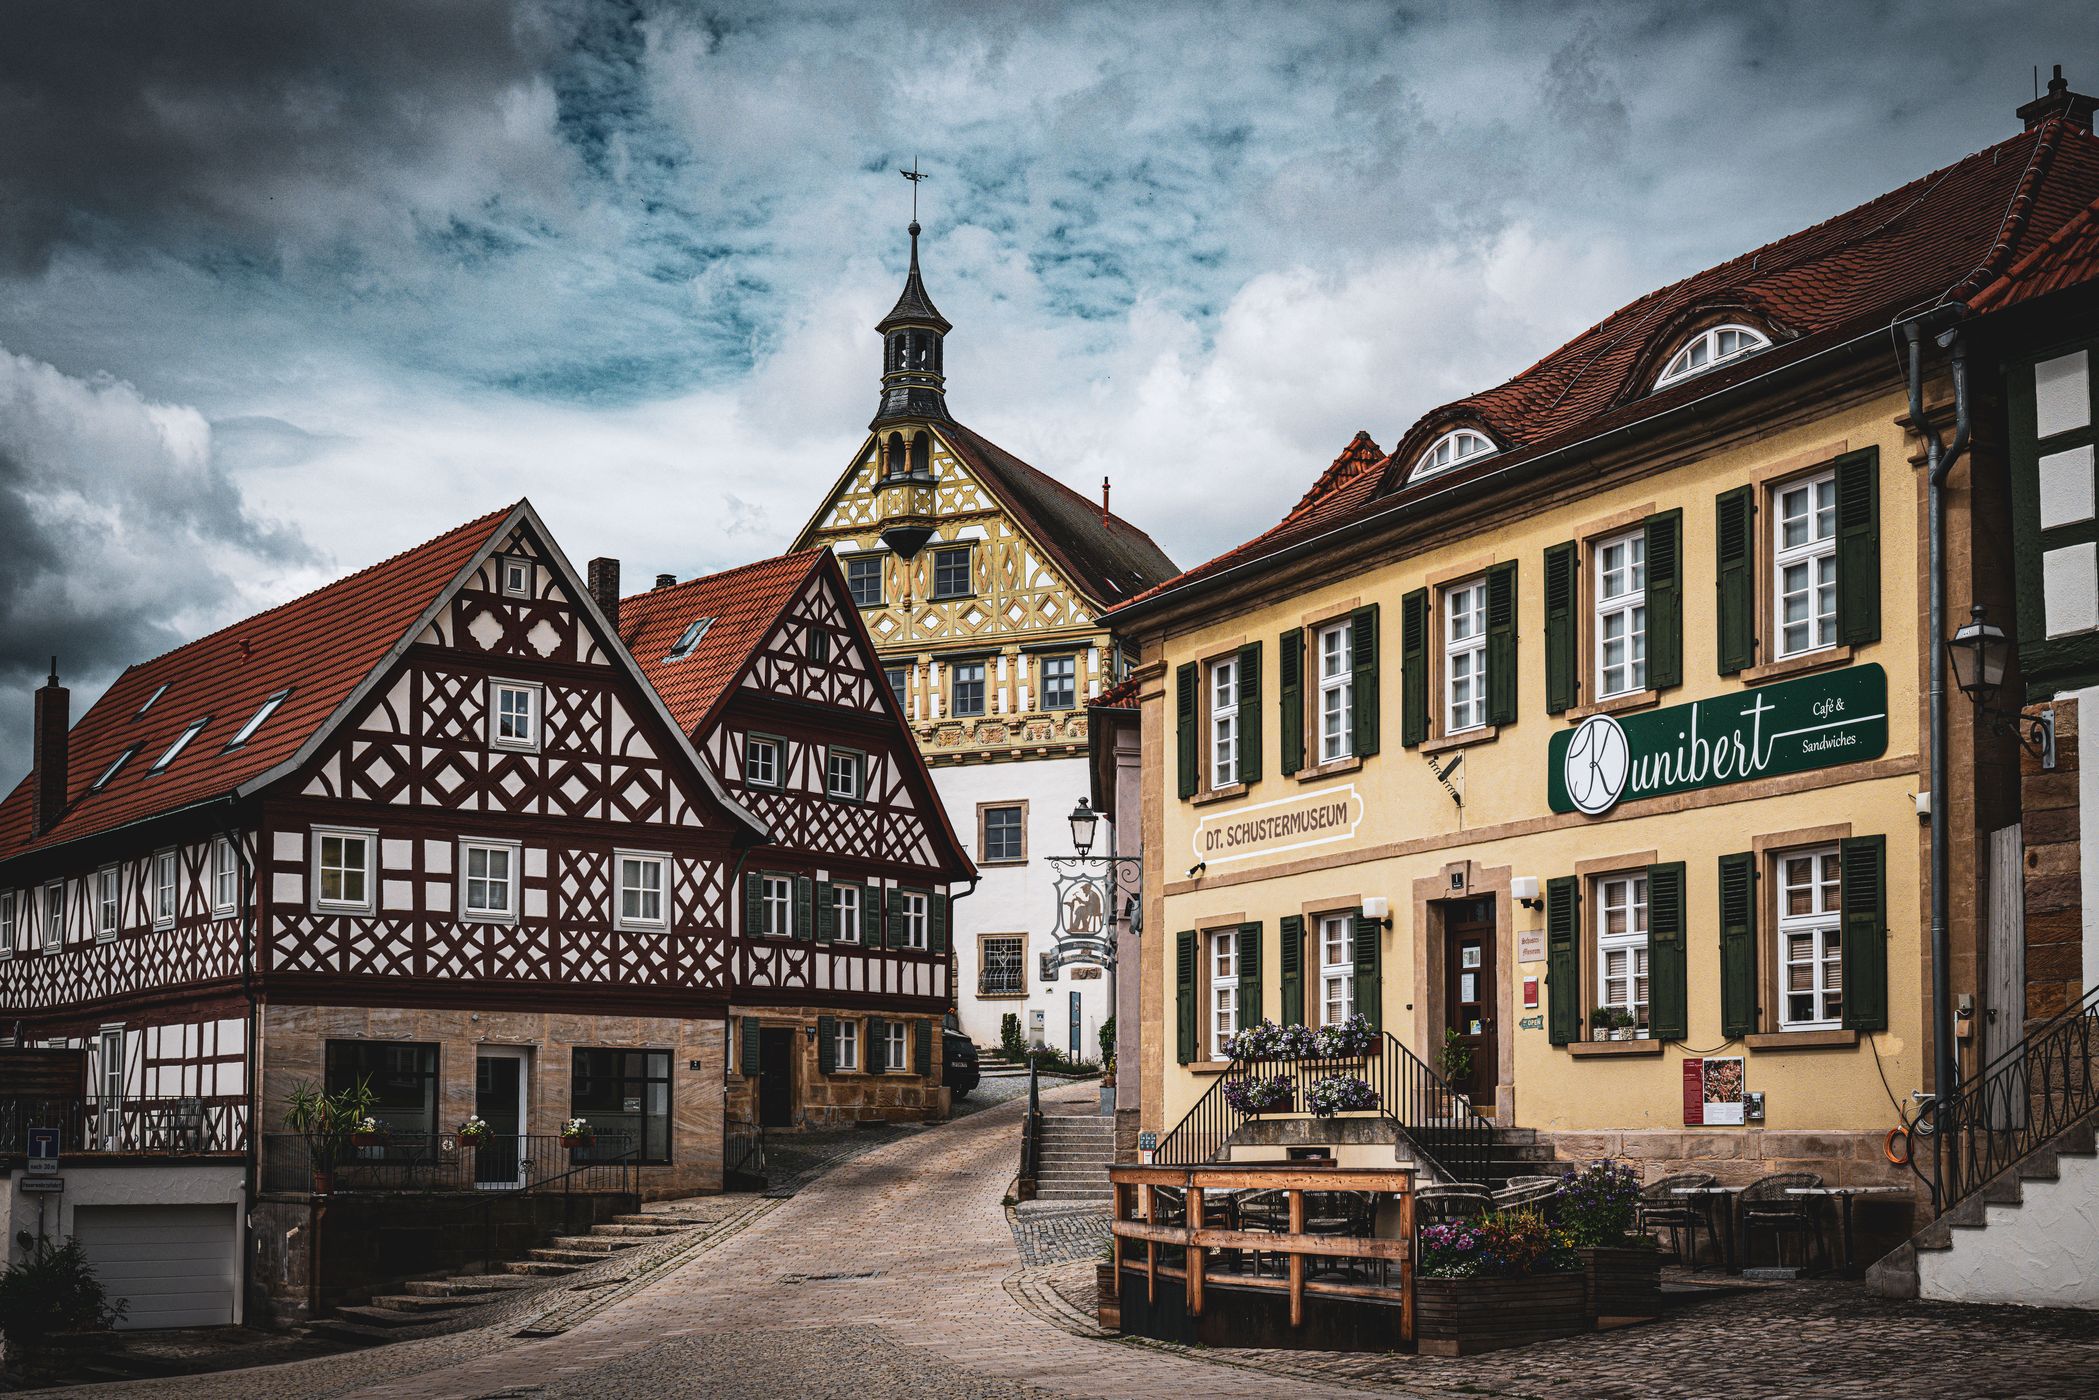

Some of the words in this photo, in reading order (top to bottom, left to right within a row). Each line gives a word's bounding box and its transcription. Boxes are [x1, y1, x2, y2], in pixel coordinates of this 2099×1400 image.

[1812, 697, 1834, 719] Café
[1835, 697, 1845, 712] &
[1569, 693, 1776, 803] Kunibert
[1802, 731, 1857, 754] Sandwiches
[1206, 828, 1224, 851] DT.
[1226, 801, 1348, 847] SCHUSTERMUSEUM
